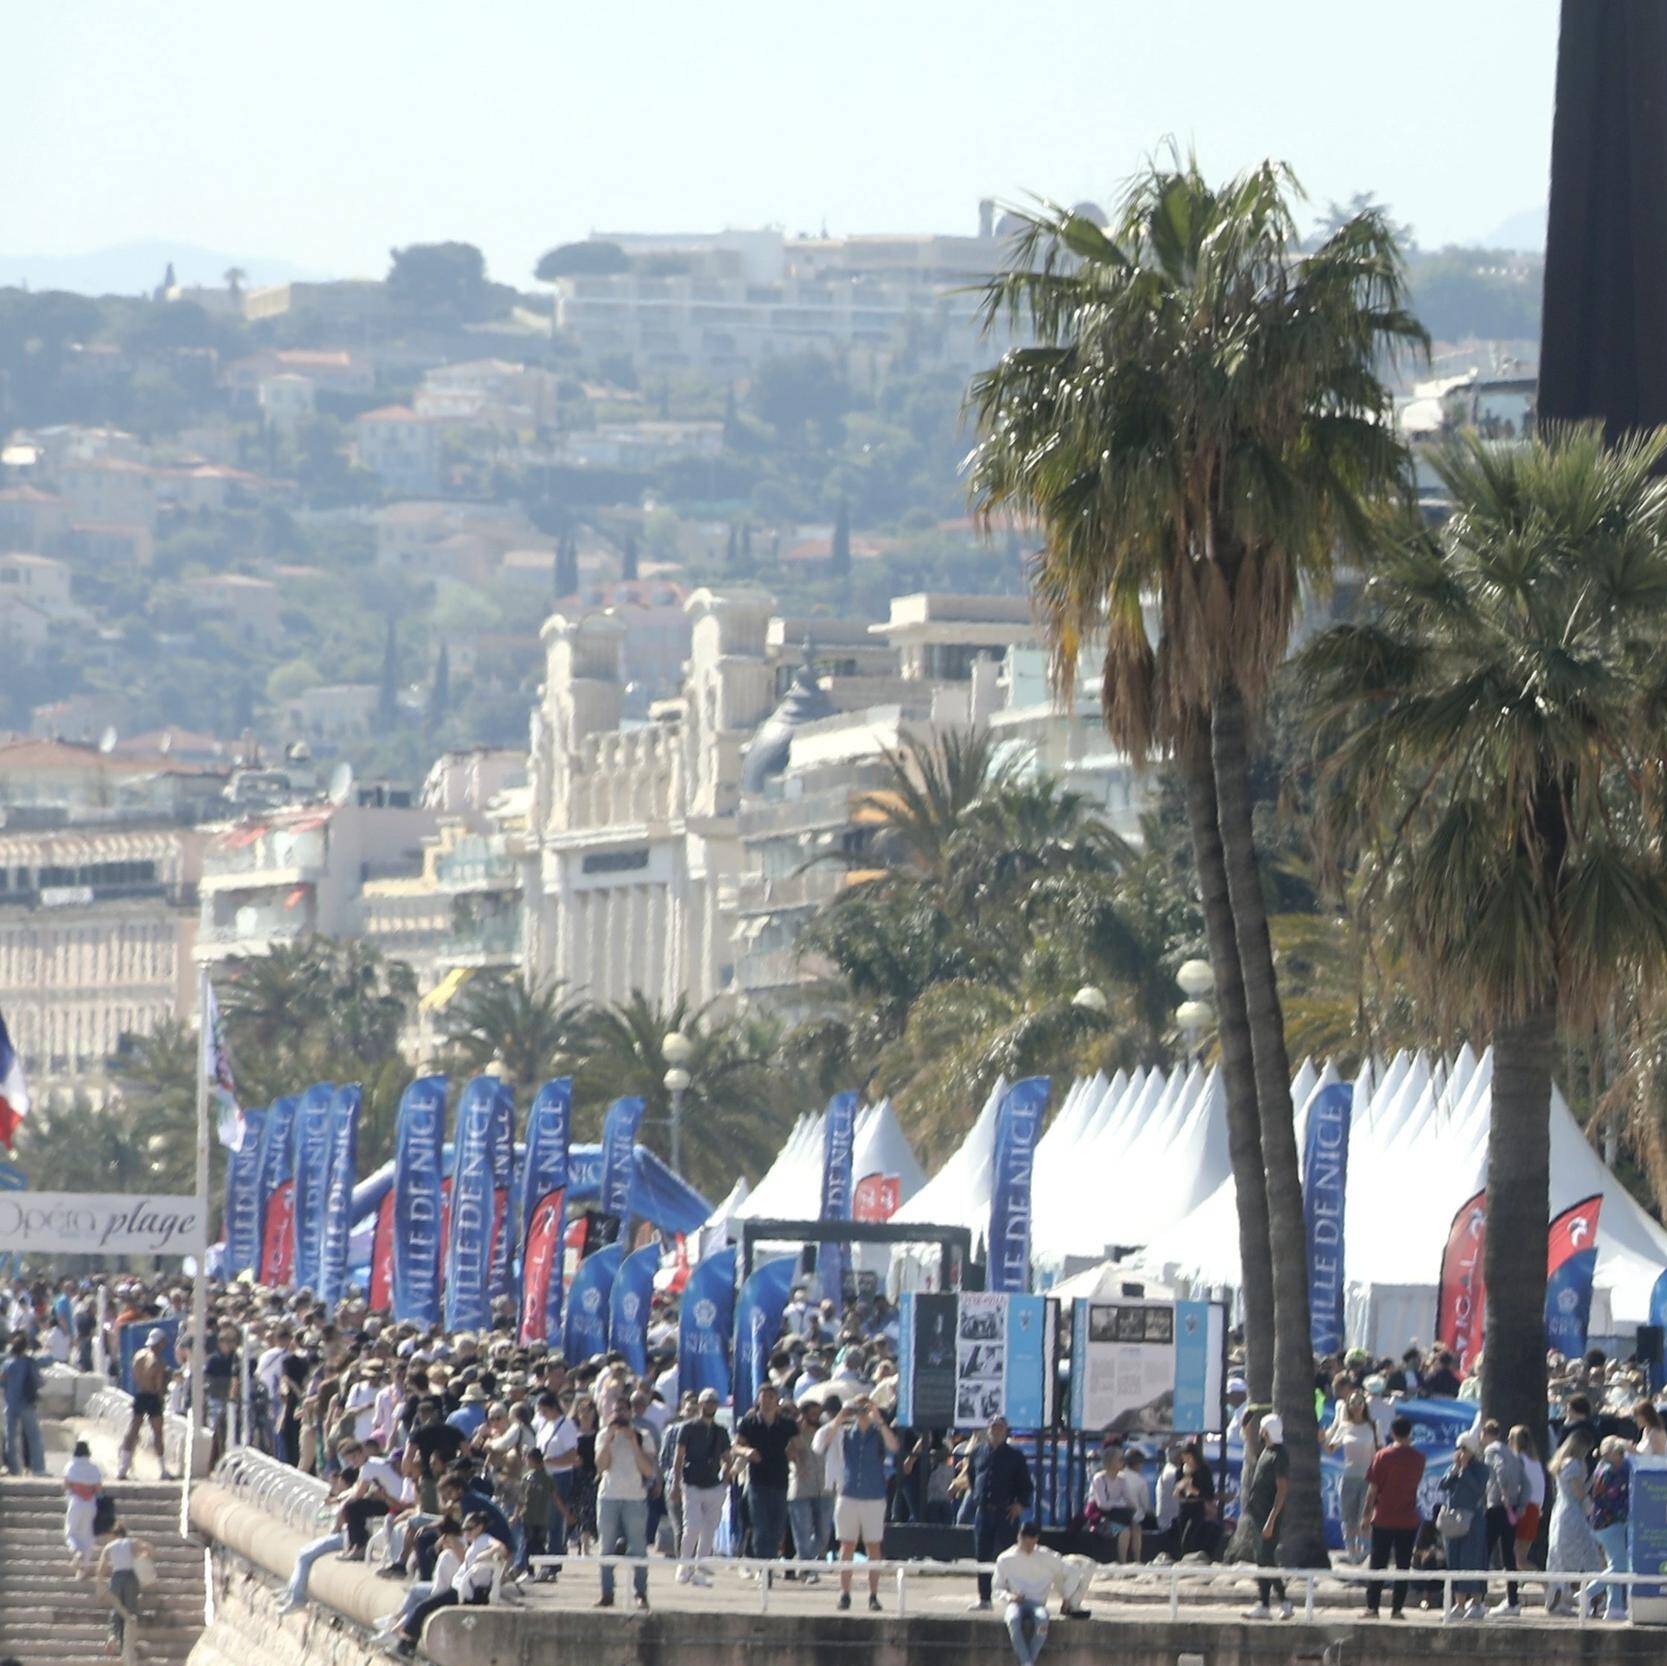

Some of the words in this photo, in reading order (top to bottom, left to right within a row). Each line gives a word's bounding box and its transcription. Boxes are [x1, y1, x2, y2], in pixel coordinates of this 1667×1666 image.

[306, 1104, 328, 1168] NICE
[408, 1097, 437, 1172] NICE
[462, 1098, 491, 1176] NICE
[537, 1100, 564, 1172] NICE
[611, 1114, 636, 1172] NICE
[831, 1109, 850, 1167] NICE
[1009, 1102, 1036, 1185] NICE
[1315, 1105, 1342, 1188] NICE
[408, 1183, 434, 1221] DE
[567, 1162, 602, 1184] NIC
[99, 1200, 197, 1248] plage
[458, 1184, 483, 1227] DE
[1006, 1197, 1028, 1240] DE
[1313, 1200, 1339, 1245] DE
[407, 1231, 435, 1310] VILLE
[454, 1239, 482, 1323] VILLE
[1311, 1255, 1337, 1345] VILLE
